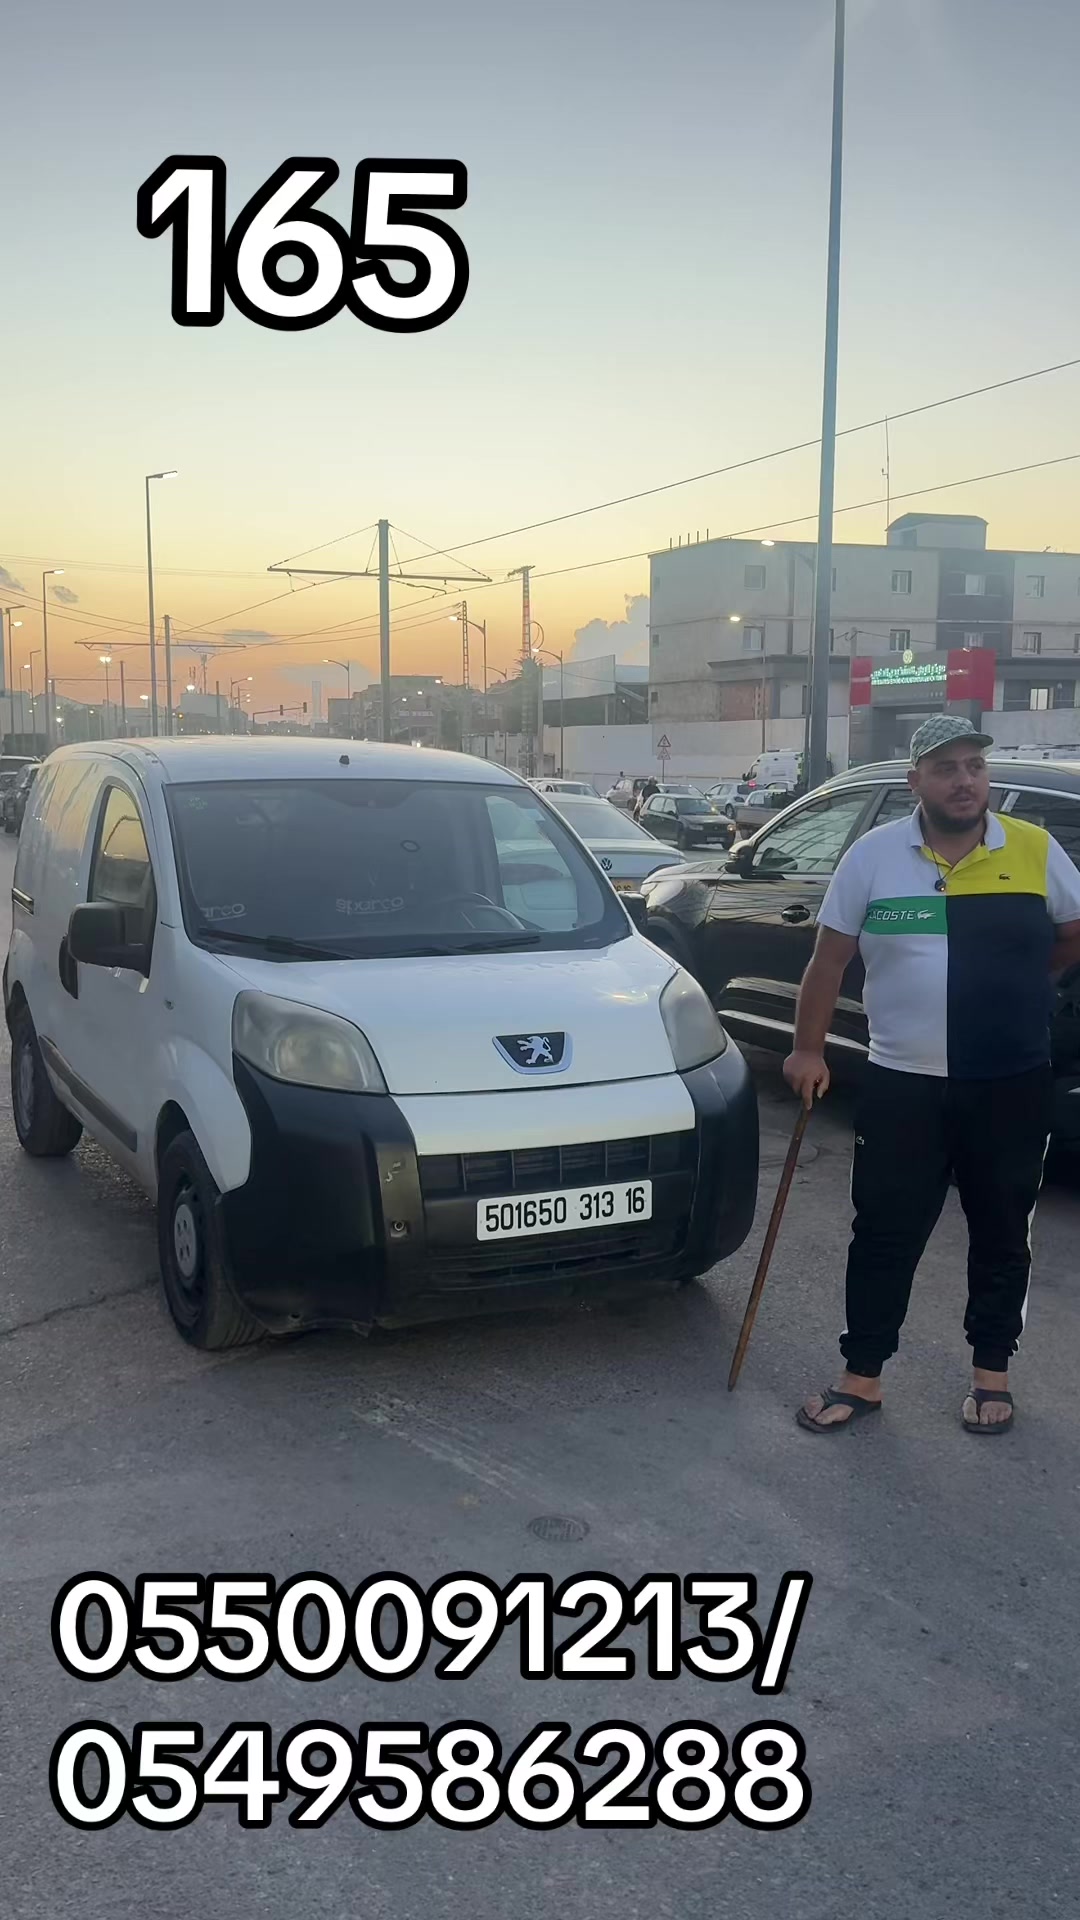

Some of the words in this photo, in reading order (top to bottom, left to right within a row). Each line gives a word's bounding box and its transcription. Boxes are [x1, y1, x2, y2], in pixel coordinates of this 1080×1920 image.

[485, 1197, 567, 1232] 501650
[579, 1191, 614, 1220] 313
[625, 1186, 645, 1214] 16
